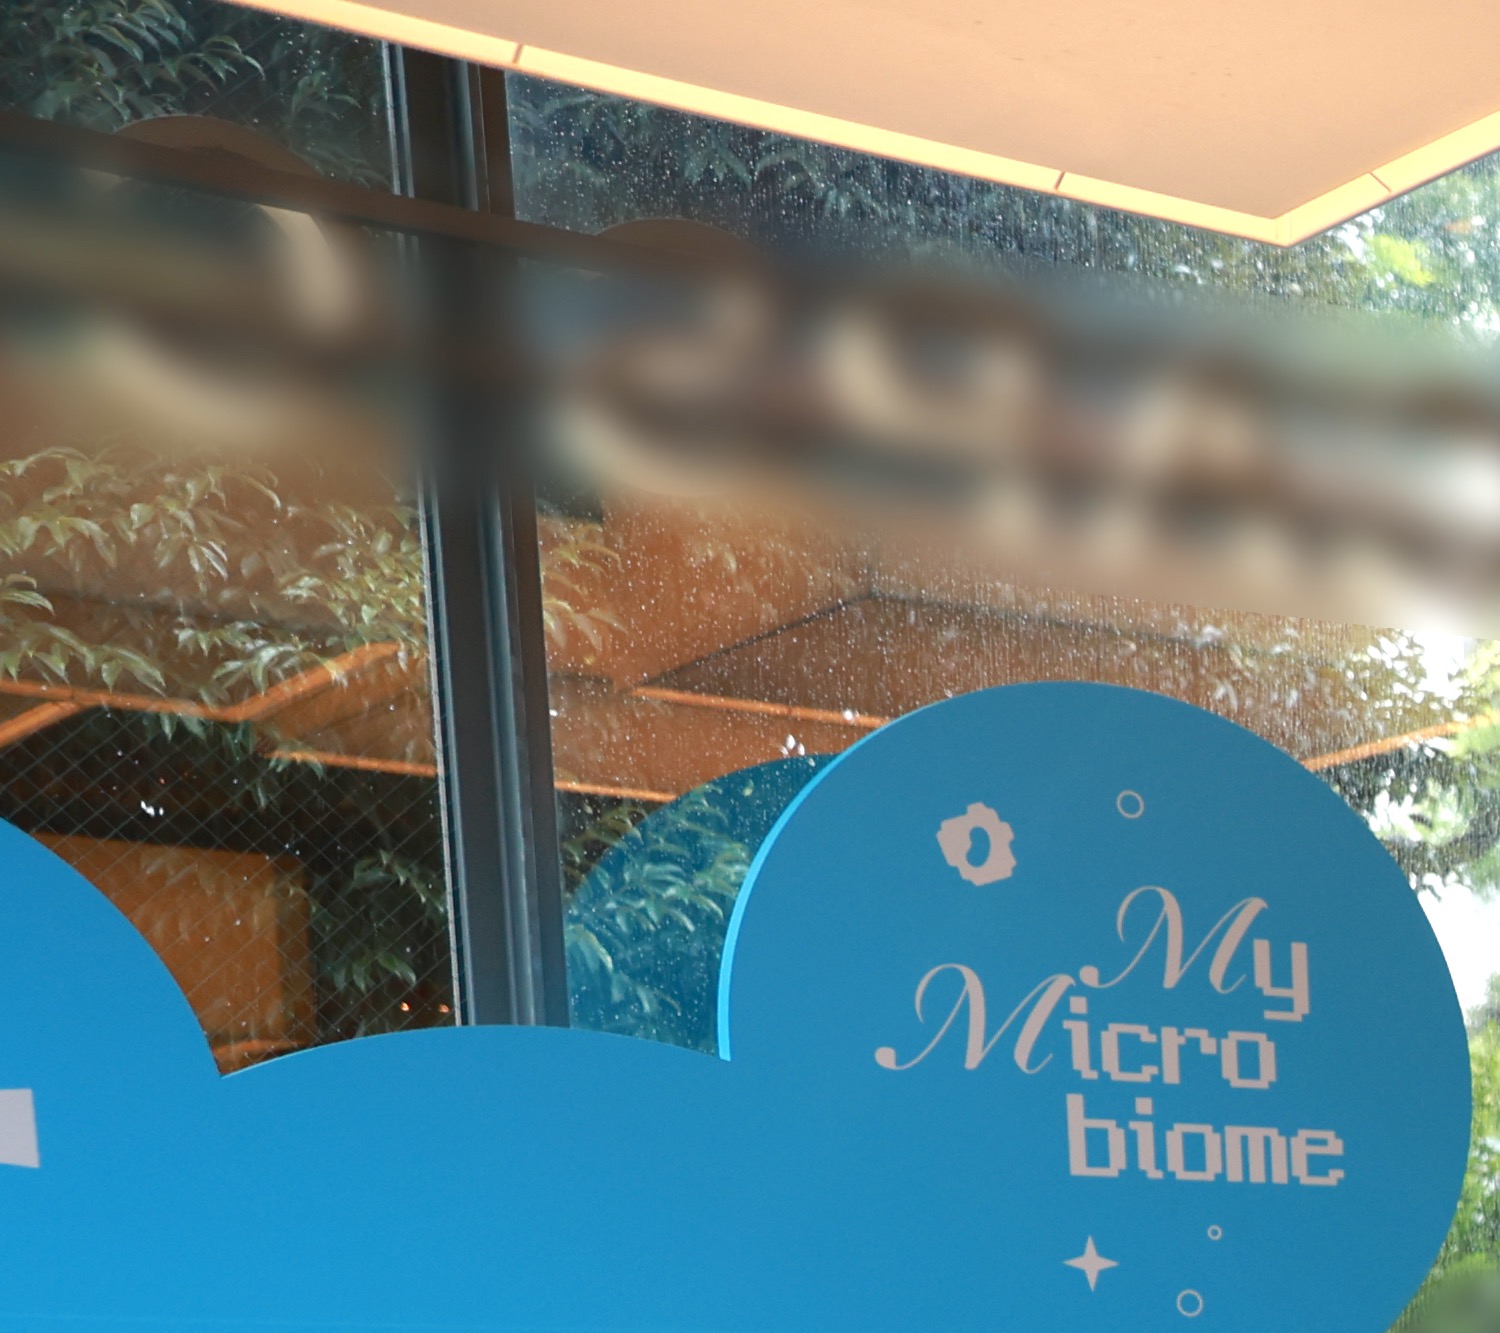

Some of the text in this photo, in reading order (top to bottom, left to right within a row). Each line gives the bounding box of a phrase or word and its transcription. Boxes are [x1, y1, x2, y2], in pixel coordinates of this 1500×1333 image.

[1079, 884, 1310, 1023] My
[874, 961, 1278, 1090] Micro
[1065, 1092, 1347, 1187] biome
